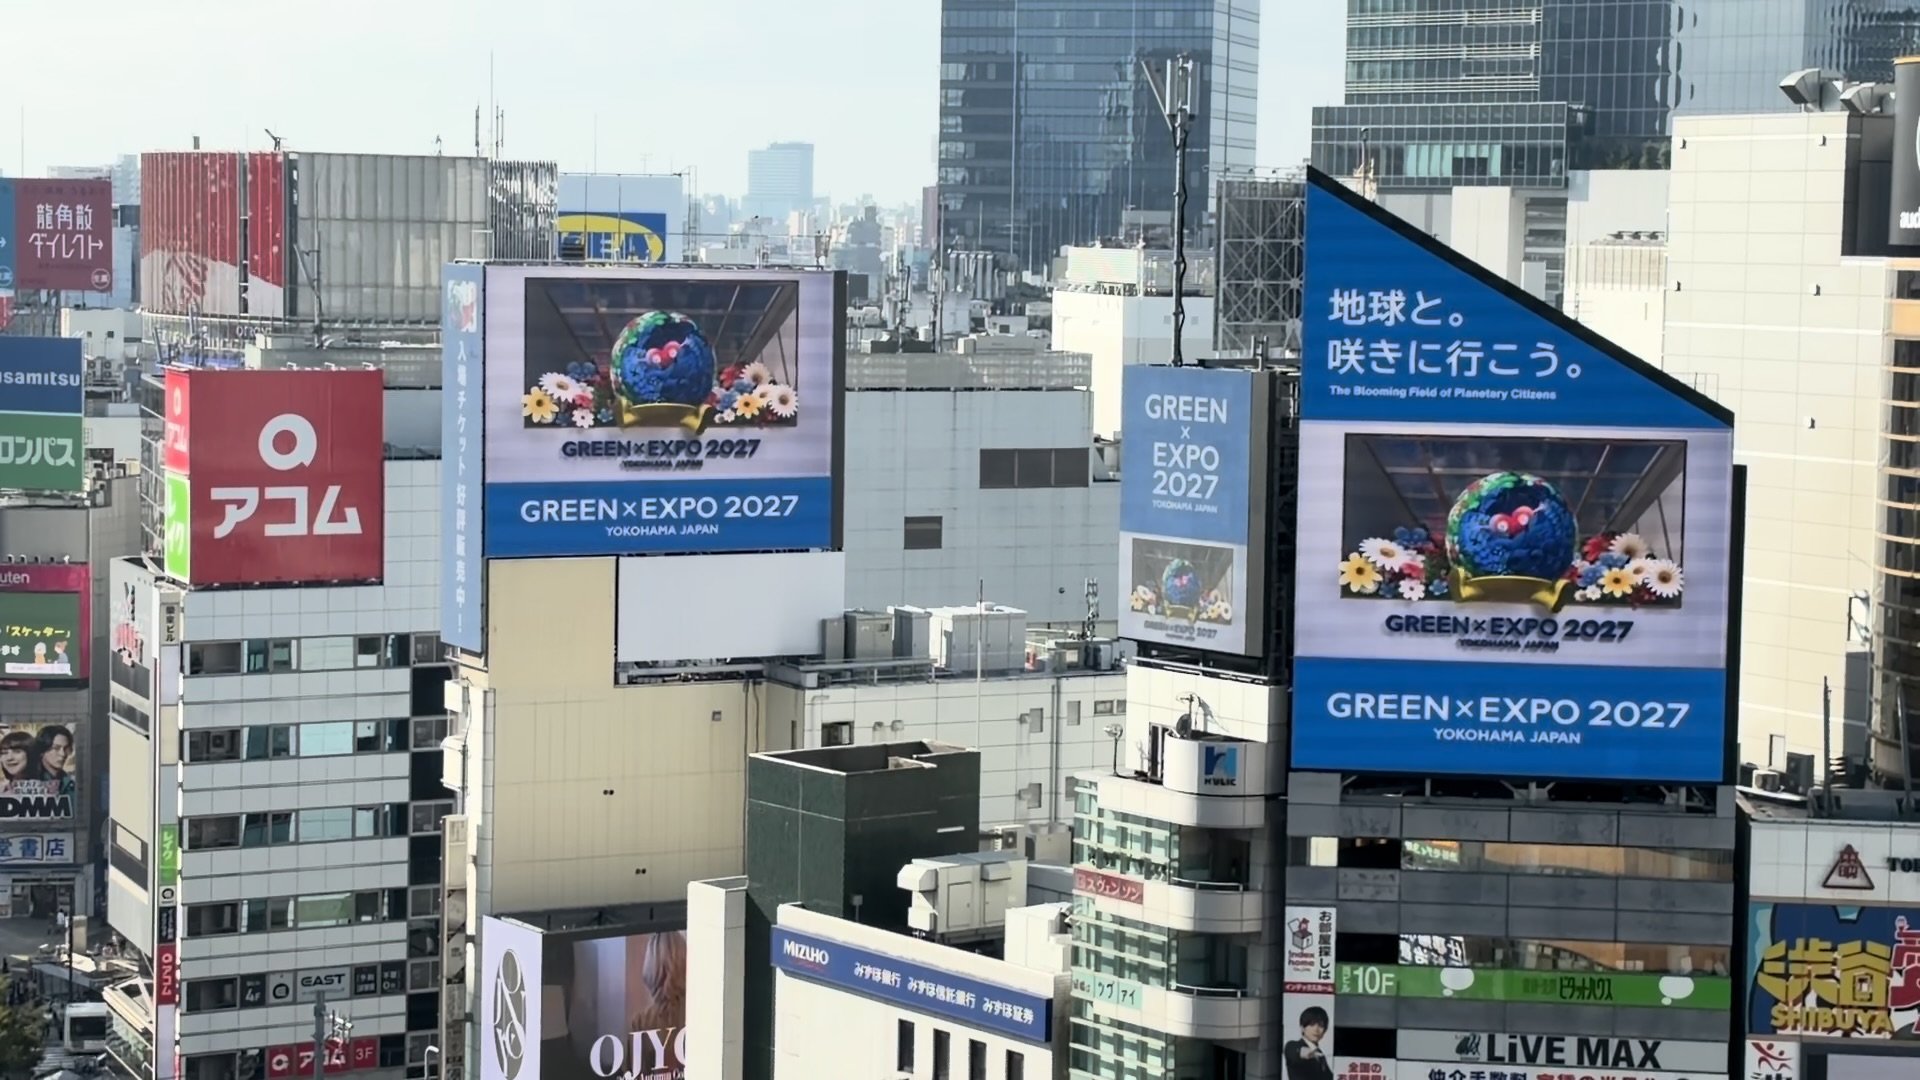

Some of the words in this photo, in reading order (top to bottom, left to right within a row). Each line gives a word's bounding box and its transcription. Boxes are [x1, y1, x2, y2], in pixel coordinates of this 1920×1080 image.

[36, 203, 93, 230] 龍角散
[28, 233, 104, 259] ダイレクト
[1328, 288, 1464, 328] 地球と。
[1327, 338, 1582, 379] 咲きに行こう。
[1329, 385, 1351, 396] The
[1354, 386, 1407, 398] Blooming
[1409, 387, 1437, 398] Field
[1439, 388, 1452, 399] of
[1454, 388, 1508, 401] Planetary
[1511, 389, 1556, 400] Citizens
[1145, 393, 1228, 424] GREEN
[705, 439, 761, 458] 2027
[1153, 442, 1220, 471] EXPO
[1152, 470, 1219, 500] 2027
[210, 485, 362, 539] アコム
[724, 495, 799, 517] 2027
[1152, 499, 1192, 511] YOKOHAMA
[1194, 502, 1218, 513] JAPAN
[606, 526, 676, 537] YOKOHAMA
[680, 524, 719, 535] JAPAN
[1562, 618, 1634, 642] 2027
[1457, 638, 1521, 650] YOKOHAMA
[1524, 640, 1559, 652] JAPAN
[1588, 699, 1690, 728] 2027
[1433, 727, 1525, 743] YOKOHAMA
[1529, 730, 1581, 745] JAPAN
[0, 796, 72, 818] DMM
[783, 938, 829, 965] MIZUHO
[1318, 911, 1332, 980] お部屋探しは
[854, 961, 901, 988] みずほ銀行
[908, 976, 976, 1009] みずほ信託銀行
[983, 996, 1034, 1025] みずほ証券
[1353, 966, 1395, 994] 10F
[1770, 1004, 1894, 1034] SHIBUYA
[356, 1047, 374, 1060] 3F
[1577, 1037, 1662, 1069] MAX
